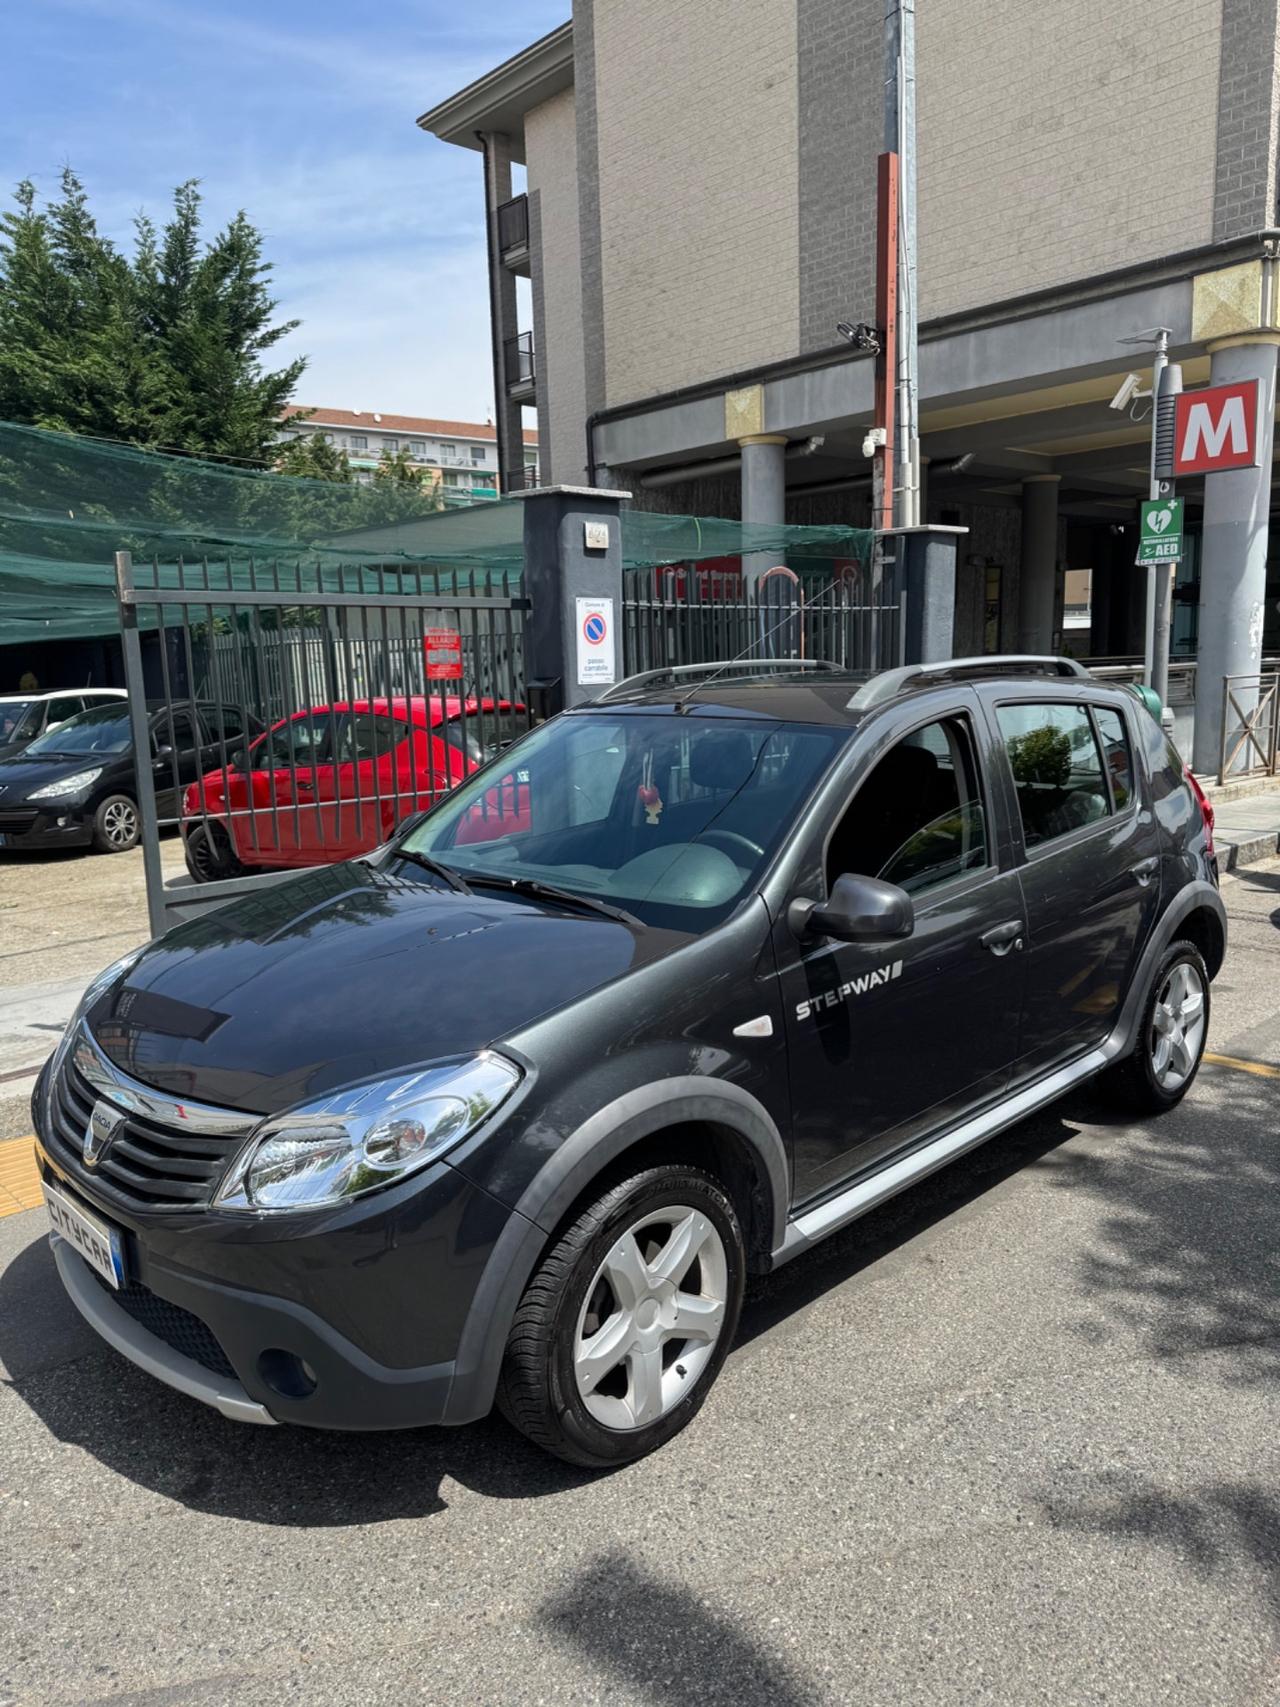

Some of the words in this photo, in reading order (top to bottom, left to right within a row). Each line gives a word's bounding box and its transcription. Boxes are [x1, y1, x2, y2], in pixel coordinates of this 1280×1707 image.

[1180, 396, 1248, 461] M
[1155, 543, 1178, 556] AED
[796, 964, 892, 1021] STEPWAY
[93, 1112, 111, 1130] DACIA
[47, 1198, 114, 1275] CITYCAR
